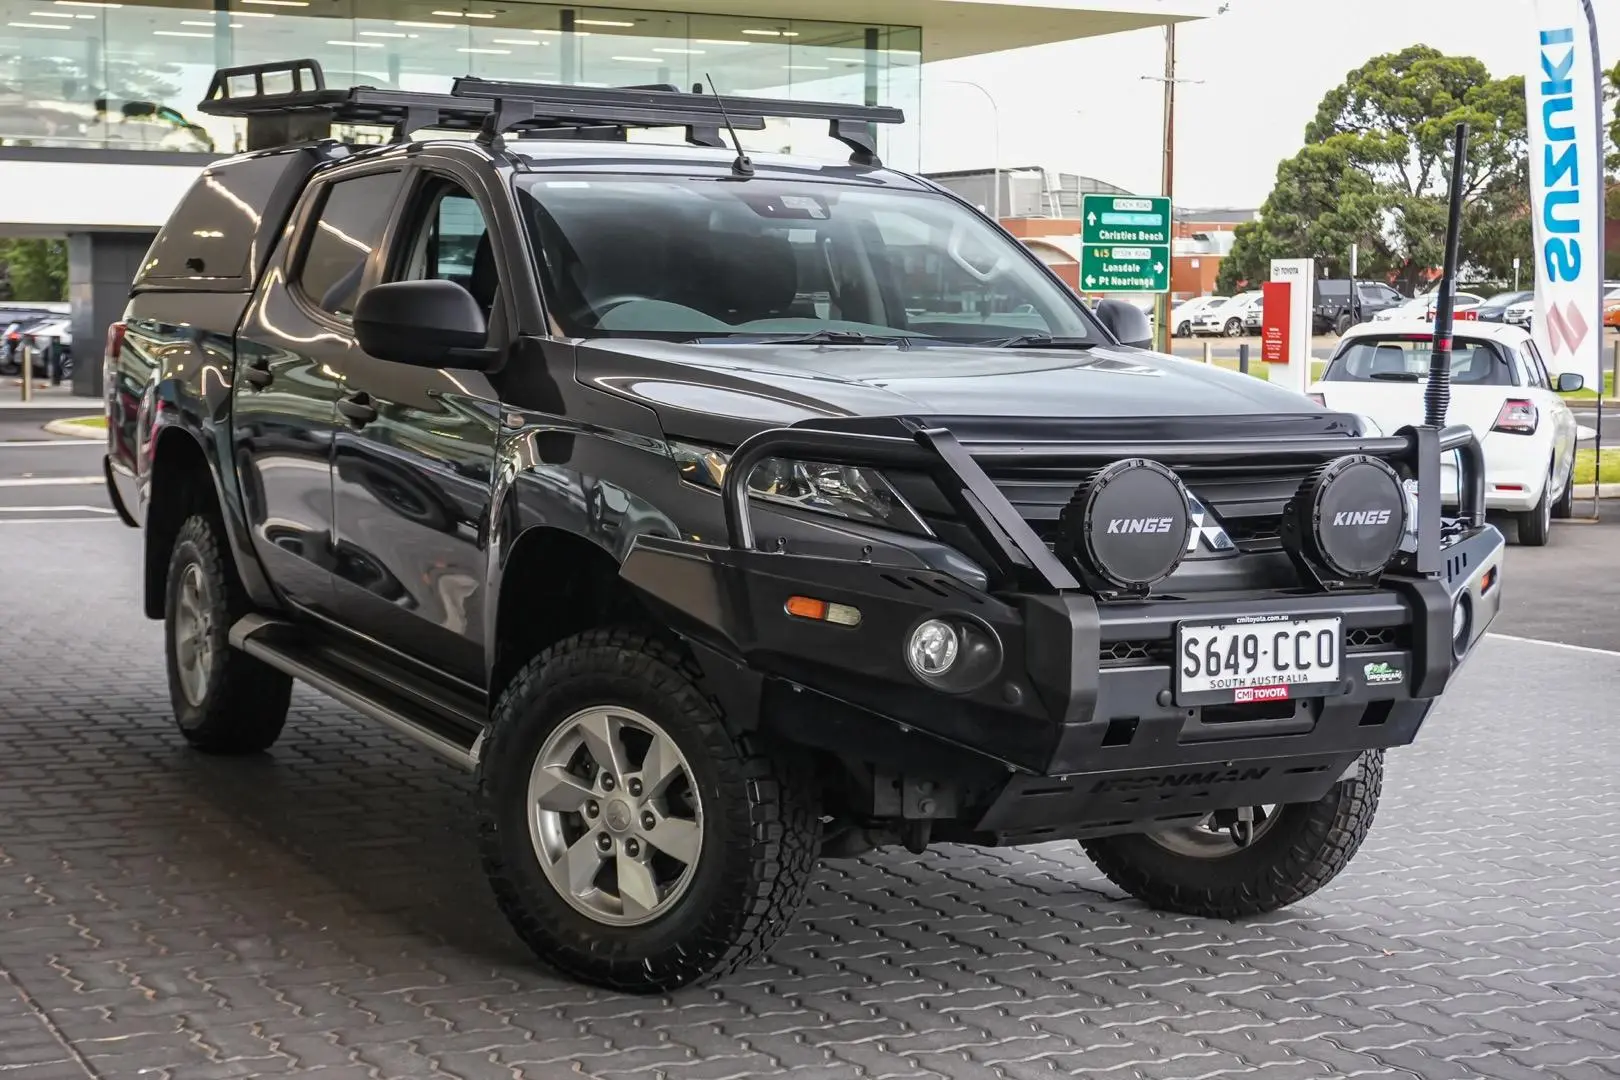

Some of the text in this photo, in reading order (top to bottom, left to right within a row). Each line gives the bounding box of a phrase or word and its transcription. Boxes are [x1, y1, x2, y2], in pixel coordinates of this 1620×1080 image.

[1099, 230, 1164, 240] Christies Beach
[1103, 262, 1140, 272] Lonsdale
[1098, 276, 1109, 285] Pt
[1333, 509, 1392, 527] KINGS
[1106, 516, 1173, 534] KINGS
[1236, 615, 1289, 624] cmitoyota.com.au
[1210, 674, 1309, 689] SOUTH AUSTRALIA
[1254, 688, 1287, 699] TOYOTA
